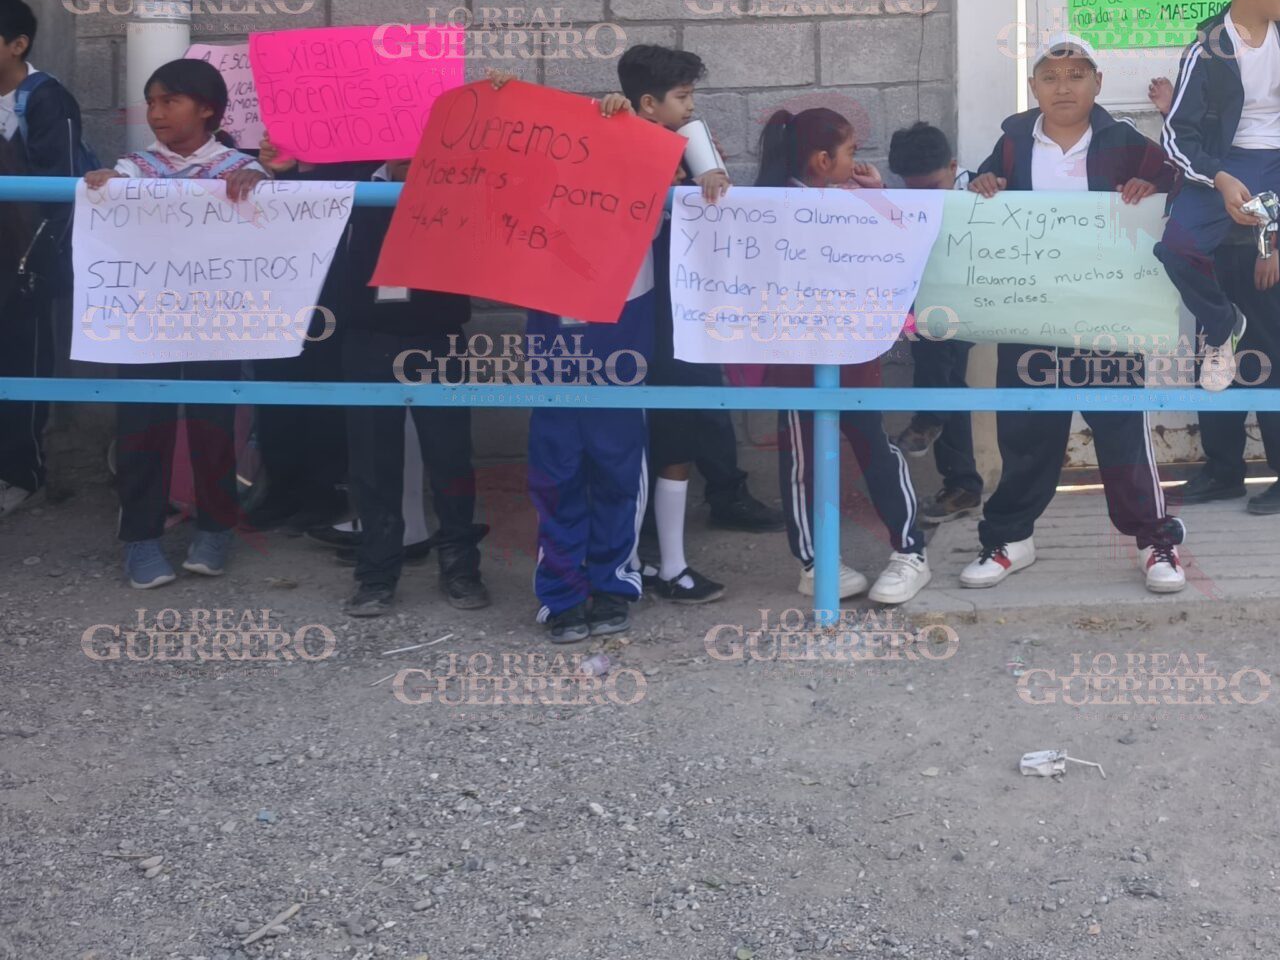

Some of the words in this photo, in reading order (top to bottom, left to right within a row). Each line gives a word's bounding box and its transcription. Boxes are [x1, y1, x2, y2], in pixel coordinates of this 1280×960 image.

[439, 87, 590, 164] Queremos
[90, 204, 131, 231] NO
[203, 201, 280, 225] AULAS
[548, 183, 620, 214] para
[630, 191, 658, 224] el
[681, 191, 778, 224] Somos
[775, 237, 809, 261] que
[820, 244, 905, 264] queremos
[947, 231, 1061, 265] Maestro
[87, 259, 157, 289] SIN
[164, 254, 299, 288] MAESTROS
[674, 264, 757, 296] Aprender
[767, 281, 789, 296] no
[966, 265, 1037, 287] llevamos
[1055, 267, 1124, 286] muchos
[1003, 292, 1048, 305] clases
